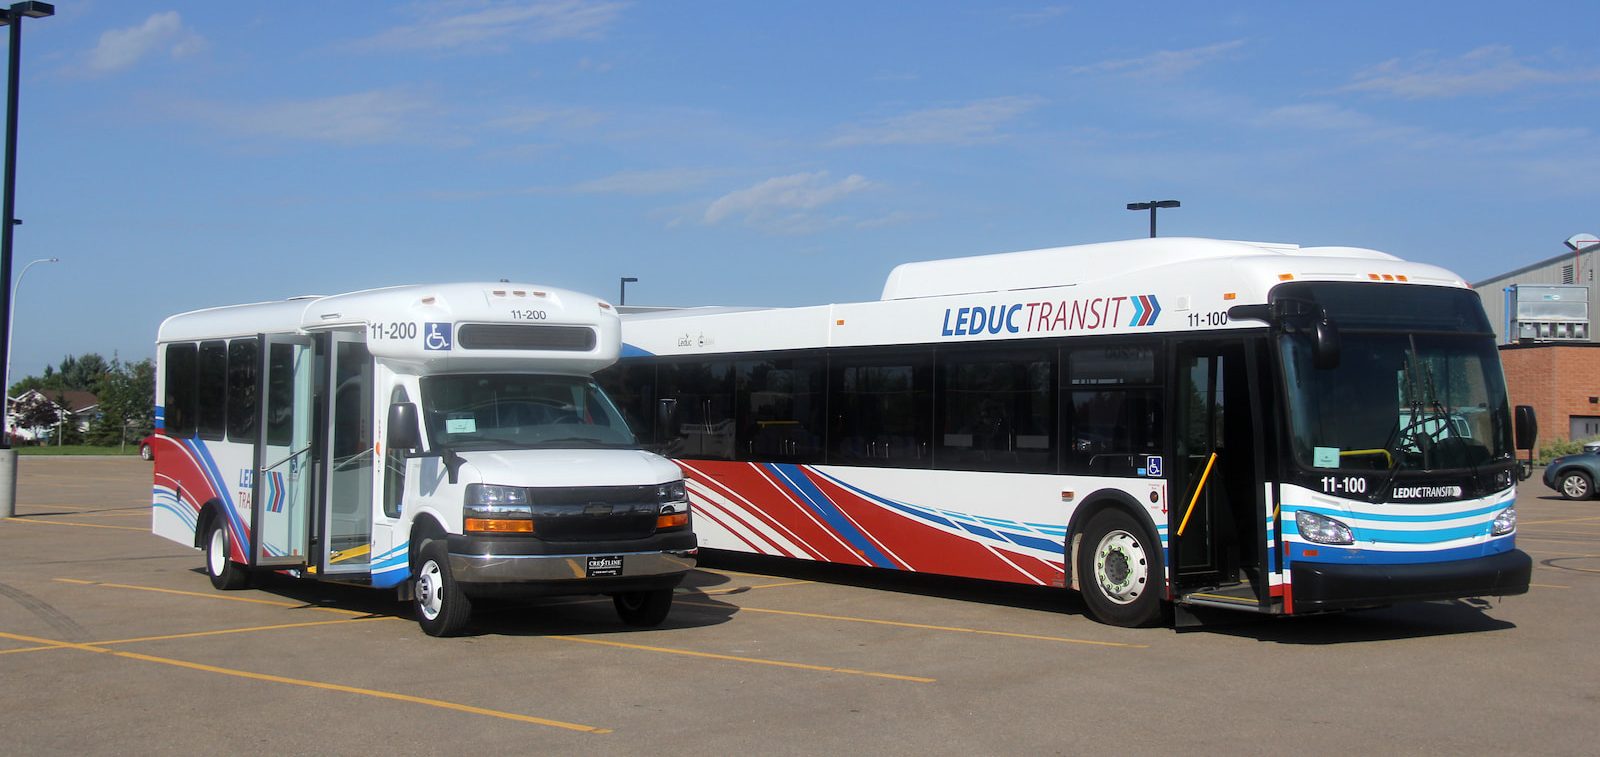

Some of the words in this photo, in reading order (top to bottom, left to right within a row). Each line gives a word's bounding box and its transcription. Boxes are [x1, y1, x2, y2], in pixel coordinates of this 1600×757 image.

[511, 310, 547, 320] 11-200
[1187, 311, 1228, 327] 11-100
[371, 322, 416, 340] 11-200
[1321, 476, 1366, 493] 11-100
